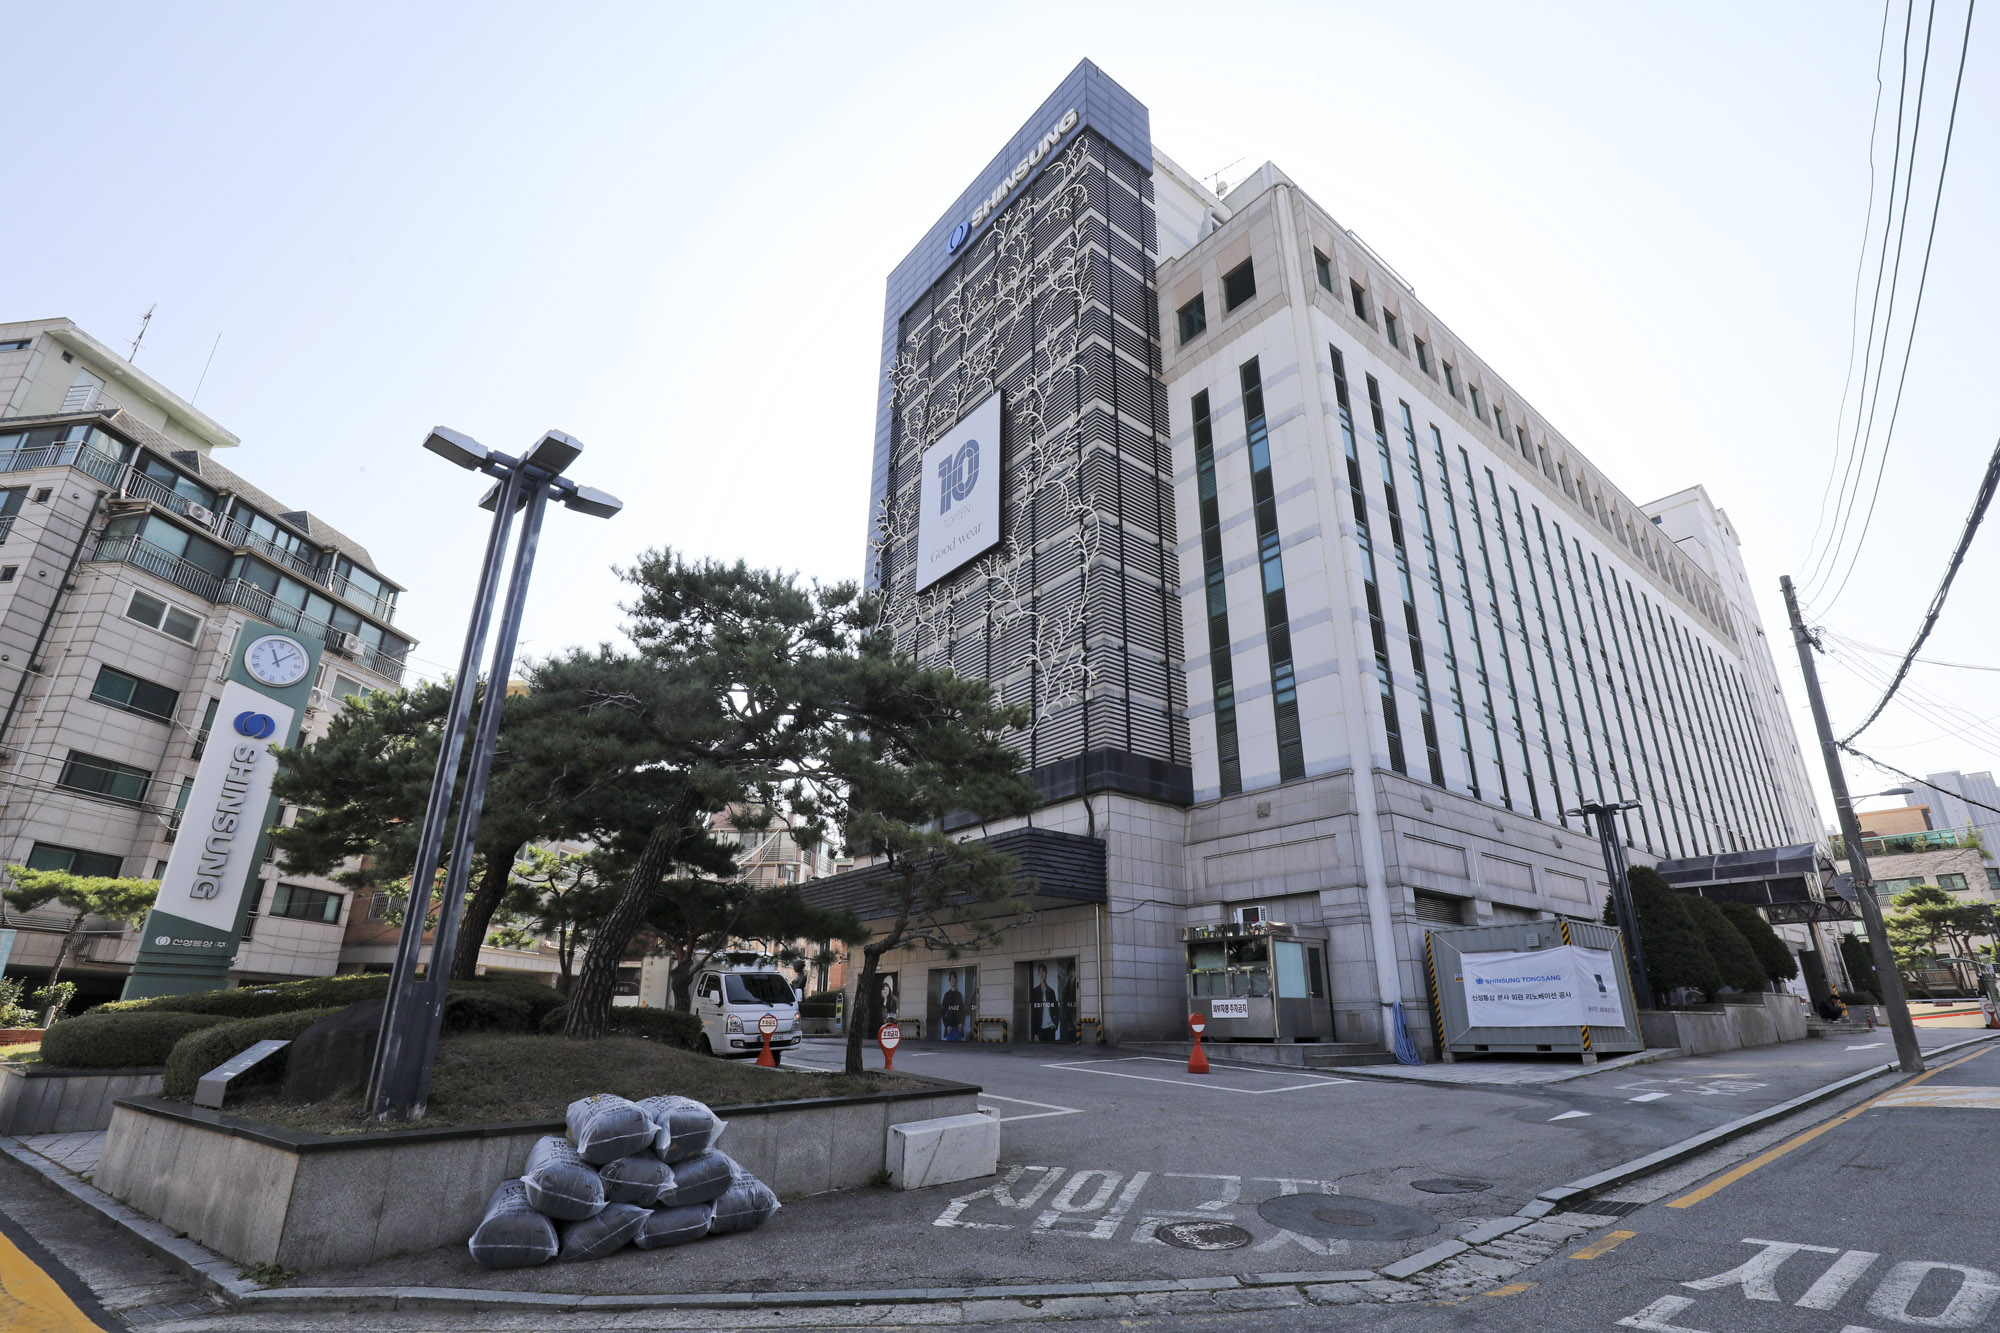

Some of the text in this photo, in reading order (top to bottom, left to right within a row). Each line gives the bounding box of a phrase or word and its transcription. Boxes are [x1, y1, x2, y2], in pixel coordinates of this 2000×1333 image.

[971, 108, 1079, 228] SHINSUNG
[930, 522, 983, 563] Good wear
[190, 743, 258, 900] SHINSUNG
[172, 938, 214, 948] 신성통상
[1485, 974, 1561, 984] SHINSUNG TONGSANG
[1526, 992, 1557, 1000] 리노베이션
[1558, 991, 1572, 999] 공사
